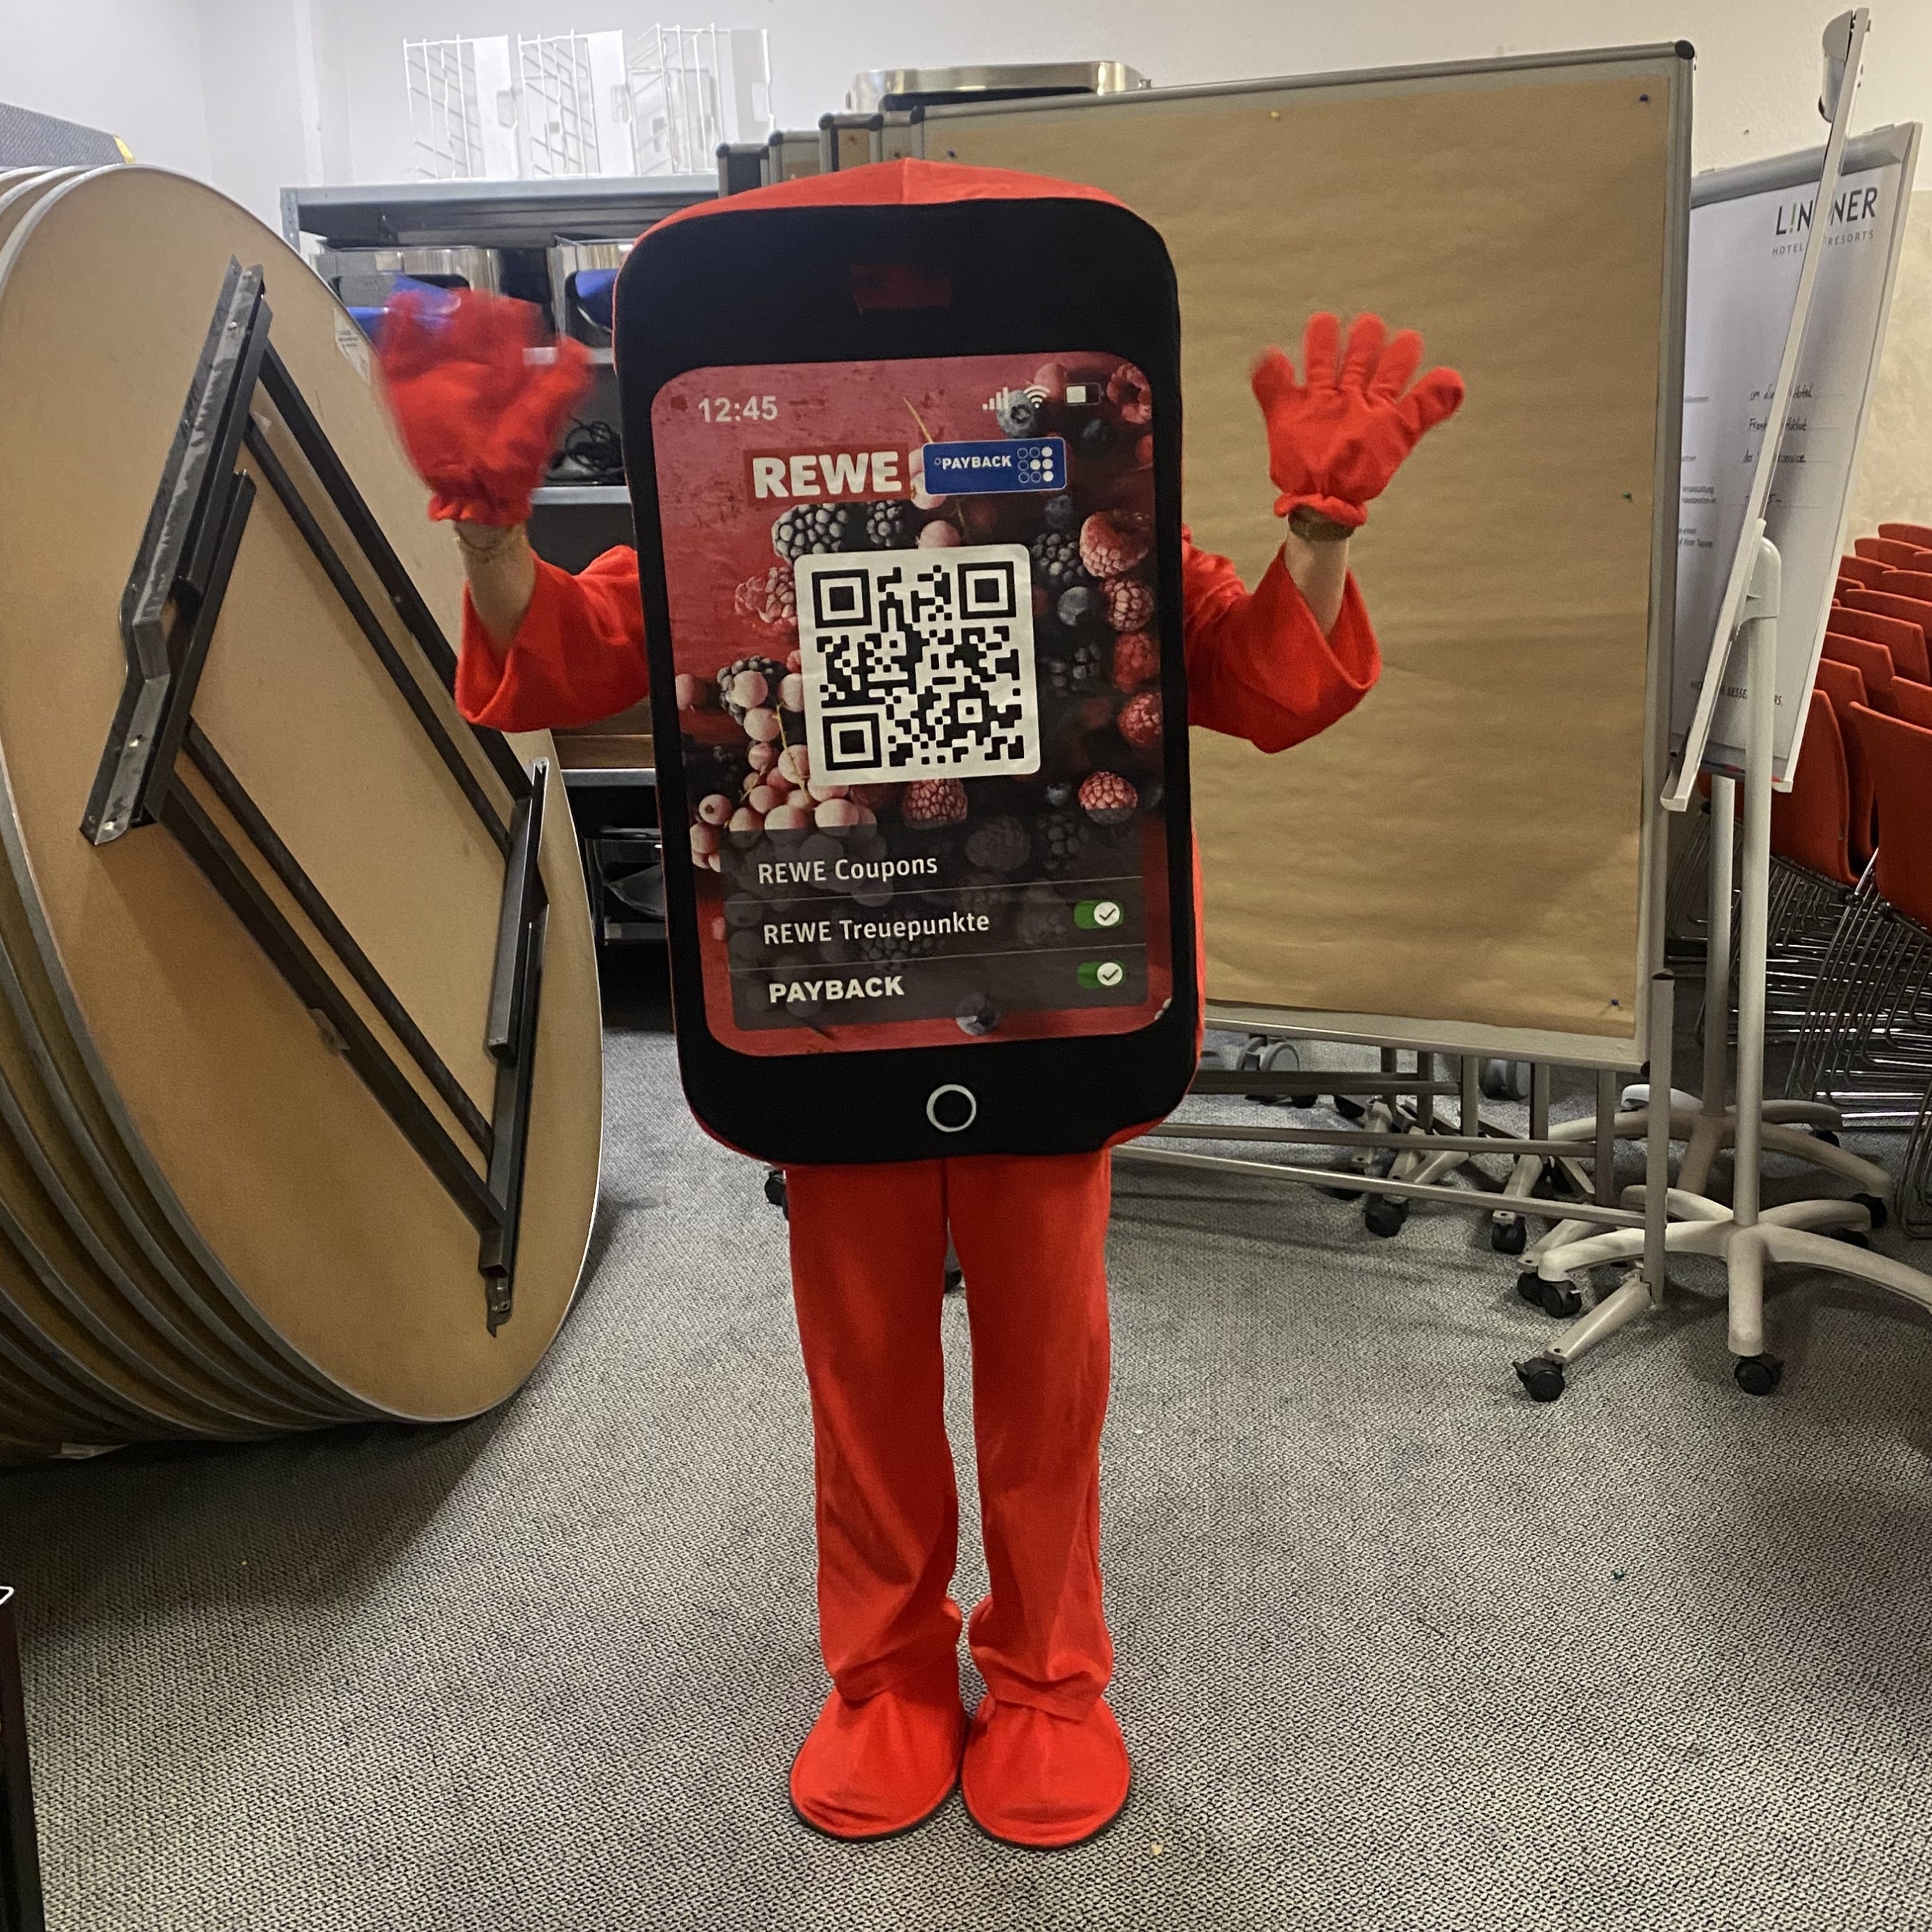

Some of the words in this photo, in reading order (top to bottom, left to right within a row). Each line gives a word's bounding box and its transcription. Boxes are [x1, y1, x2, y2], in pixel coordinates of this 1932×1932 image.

[1776, 187, 1878, 235] L!NNER
[1772, 243, 1807, 256] HOTEL
[1828, 229, 1874, 246] RESORTS
[698, 395, 778, 422] 12:45
[753, 451, 903, 499] REWE
[941, 455, 1012, 470] PAYBACK
[757, 860, 827, 884] REWE
[835, 856, 938, 882] Coupons
[763, 921, 832, 944] REWE
[839, 912, 990, 942] Treuepunkte
[769, 975, 905, 1003] PAYBACK
